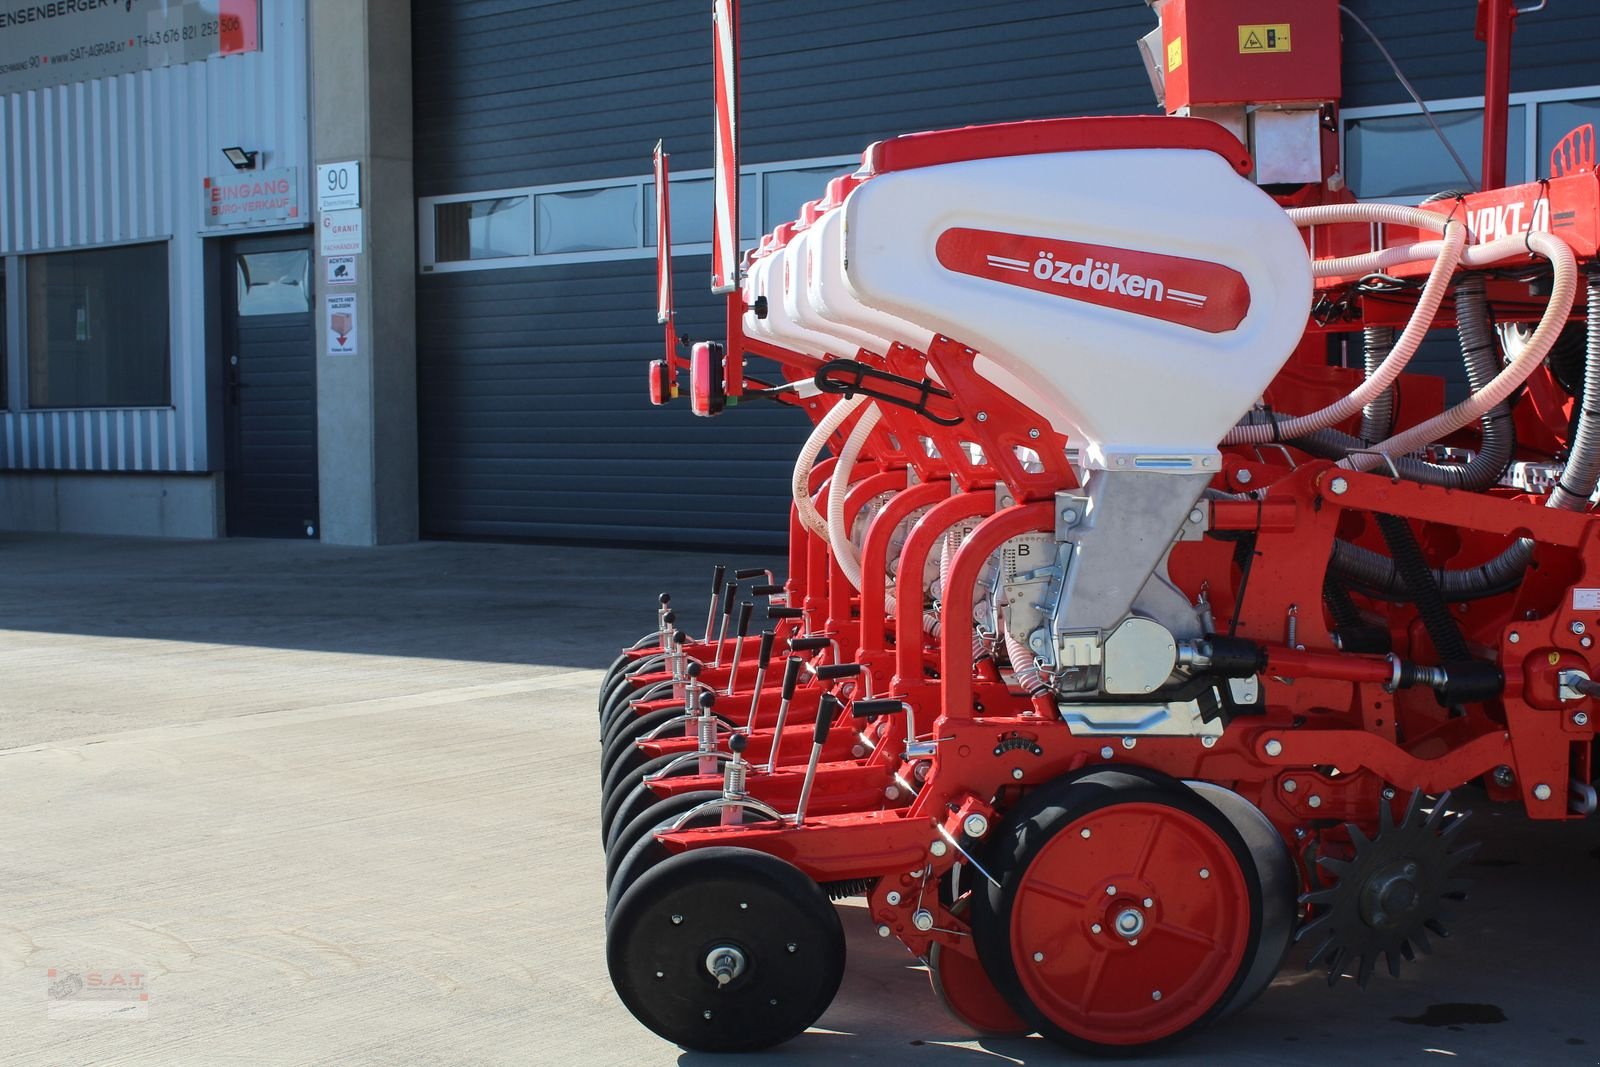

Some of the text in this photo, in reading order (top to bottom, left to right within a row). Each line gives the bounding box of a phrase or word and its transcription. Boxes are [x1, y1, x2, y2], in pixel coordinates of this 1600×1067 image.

[163, 28, 180, 43] 676
[182, 25, 198, 40] 821
[201, 20, 218, 36] 252
[221, 16, 240, 32] 506
[211, 179, 289, 201] EINGANG
[328, 168, 348, 191] 90
[332, 224, 358, 234] GRANIT
[1033, 251, 1164, 302] özdöken
[1018, 544, 1030, 556] B
